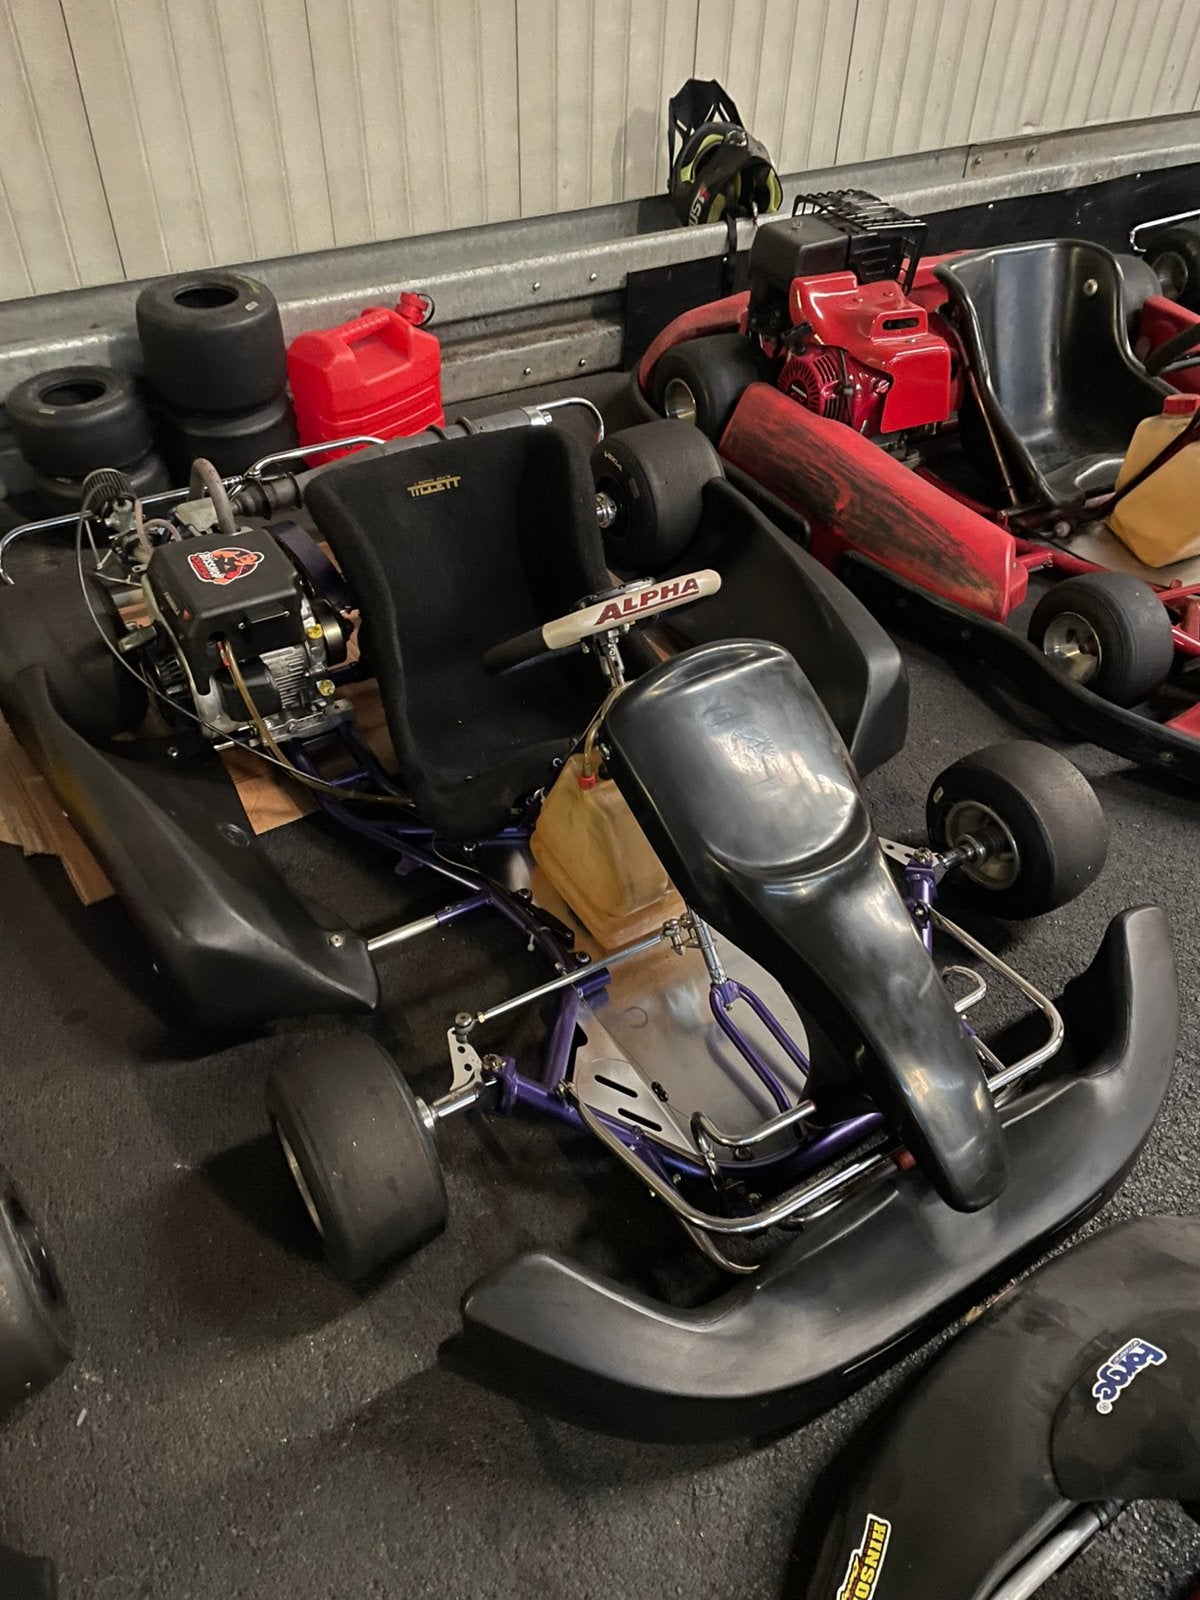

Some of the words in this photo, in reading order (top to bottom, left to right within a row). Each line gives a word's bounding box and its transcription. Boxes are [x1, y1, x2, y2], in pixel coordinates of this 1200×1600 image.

[594, 577, 700, 626] ALPHA
[1095, 1343, 1164, 1400] Forge
[853, 1521, 888, 1600] HINSO
